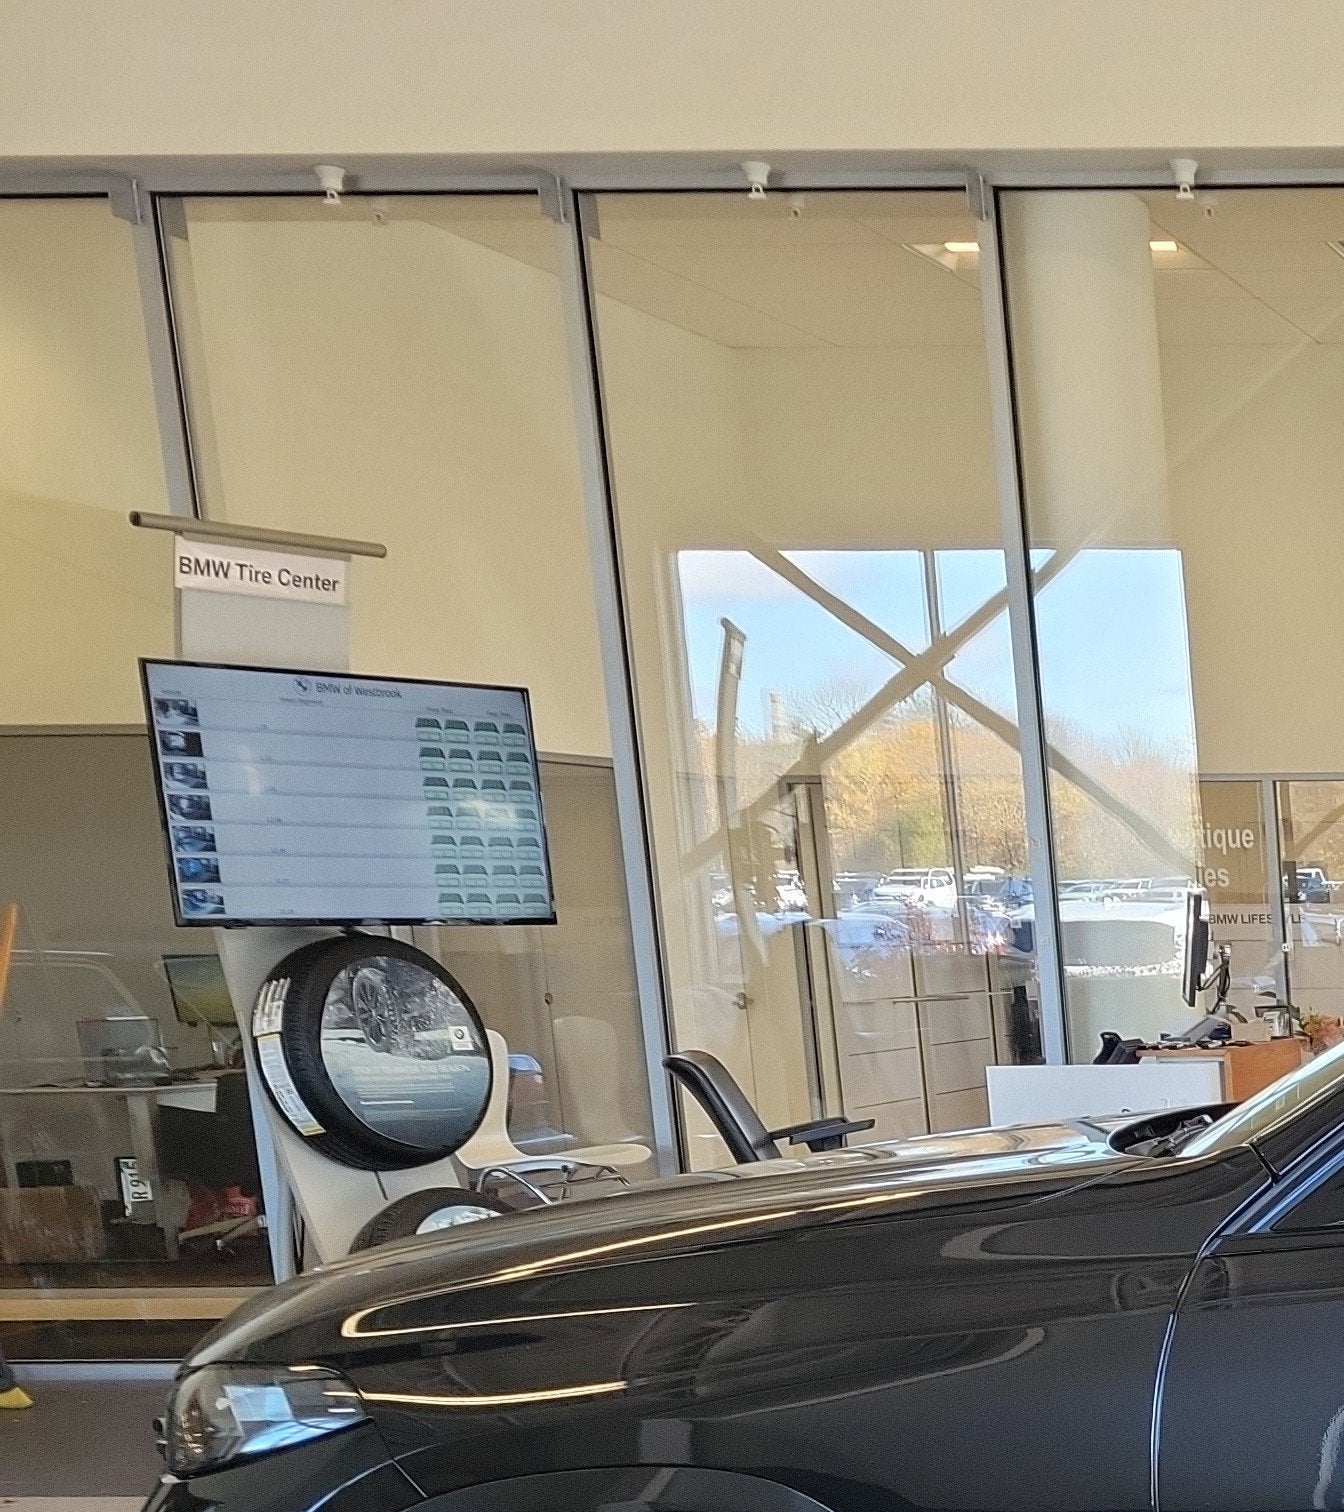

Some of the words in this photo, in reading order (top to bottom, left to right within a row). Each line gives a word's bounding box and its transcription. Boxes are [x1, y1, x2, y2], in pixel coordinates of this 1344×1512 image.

[178, 555, 231, 579] BMW
[235, 562, 272, 584] Tire
[277, 567, 339, 592] Center
[315, 682, 341, 695] BMW
[343, 684, 353, 695] of
[1208, 913, 1238, 925] BMW
